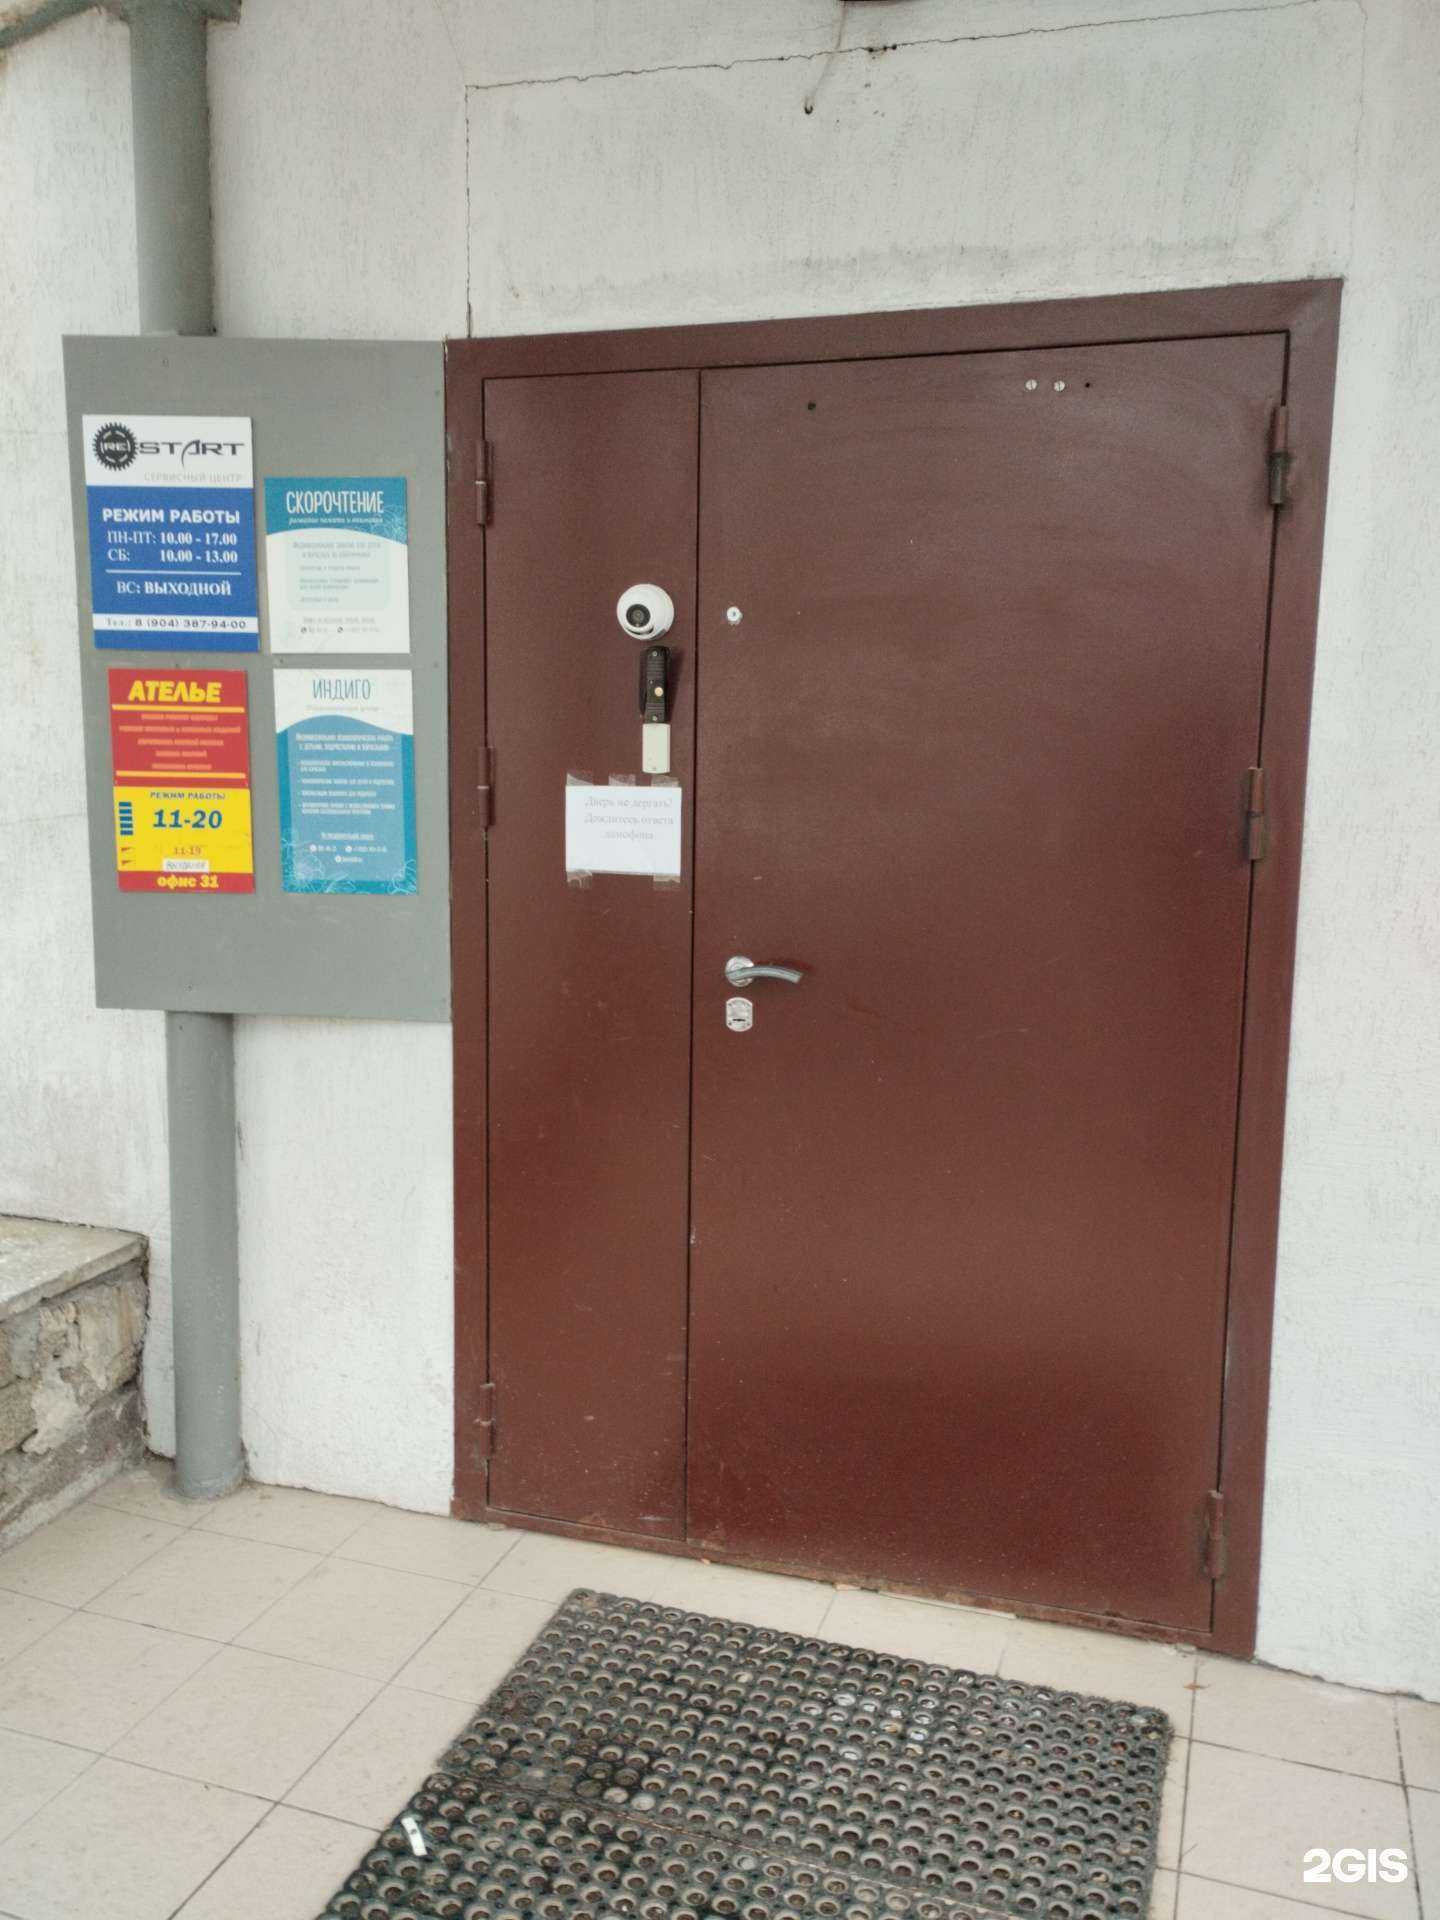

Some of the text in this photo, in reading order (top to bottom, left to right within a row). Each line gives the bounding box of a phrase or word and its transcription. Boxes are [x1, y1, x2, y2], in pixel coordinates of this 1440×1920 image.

[144, 471, 242, 483] СЕРВИСНЫЙ ЦЕНТР
[286, 490, 384, 514] СКОРОЧТЕНИЕ
[102, 508, 240, 525] РЕЖИМ РАБОТЫ
[107, 530, 157, 545] ПН-ПТ:
[160, 531, 192, 545] 10.00
[205, 532, 237, 545] 17.00
[107, 549, 130, 562] СБ:
[160, 550, 193, 563] 10.00
[205, 550, 238, 564] 13.00
[117, 580, 232, 597] ВС: ВЫХОДНОЙ
[135, 618, 143, 628] 8
[147, 617, 180, 630] (904)
[183, 618, 246, 630] 387-94-00
[129, 679, 222, 703] АТЕЛЬЕ
[312, 678, 371, 702] ИНДИГО
[150, 791, 225, 800] РЕЖИМ РАБОТЫ
[585, 796, 615, 809] Дверь
[617, 799, 628, 808] не
[153, 809, 223, 829] 11-20
[640, 815, 674, 826] ответа
[157, 874, 219, 890] офис 31
